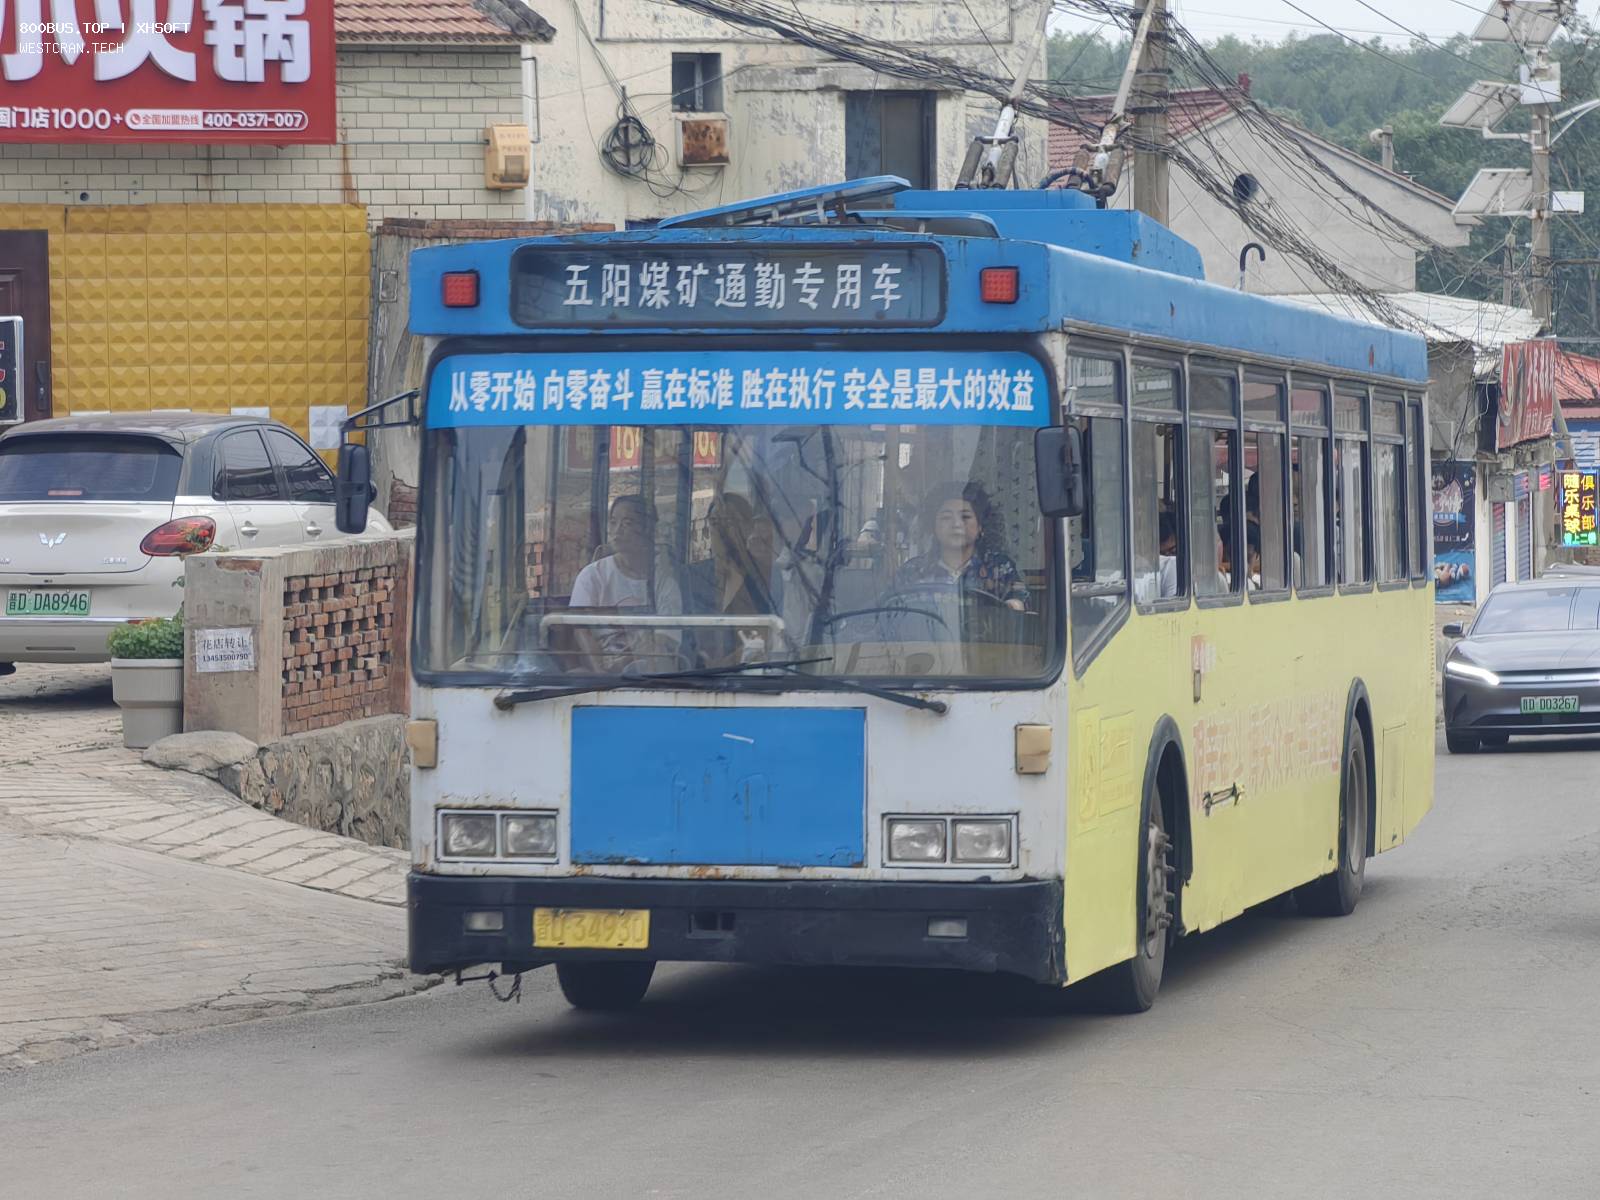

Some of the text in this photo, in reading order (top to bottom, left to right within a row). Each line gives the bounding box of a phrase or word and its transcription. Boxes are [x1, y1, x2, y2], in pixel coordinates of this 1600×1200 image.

[142, 114, 199, 126] 全国加盟热线
[562, 261, 902, 309] 五阳煤矿通勤专用车
[449, 368, 1035, 412] 从零开始 向零奋斗 赢在标准 胜在执行 安全是最大的效益
